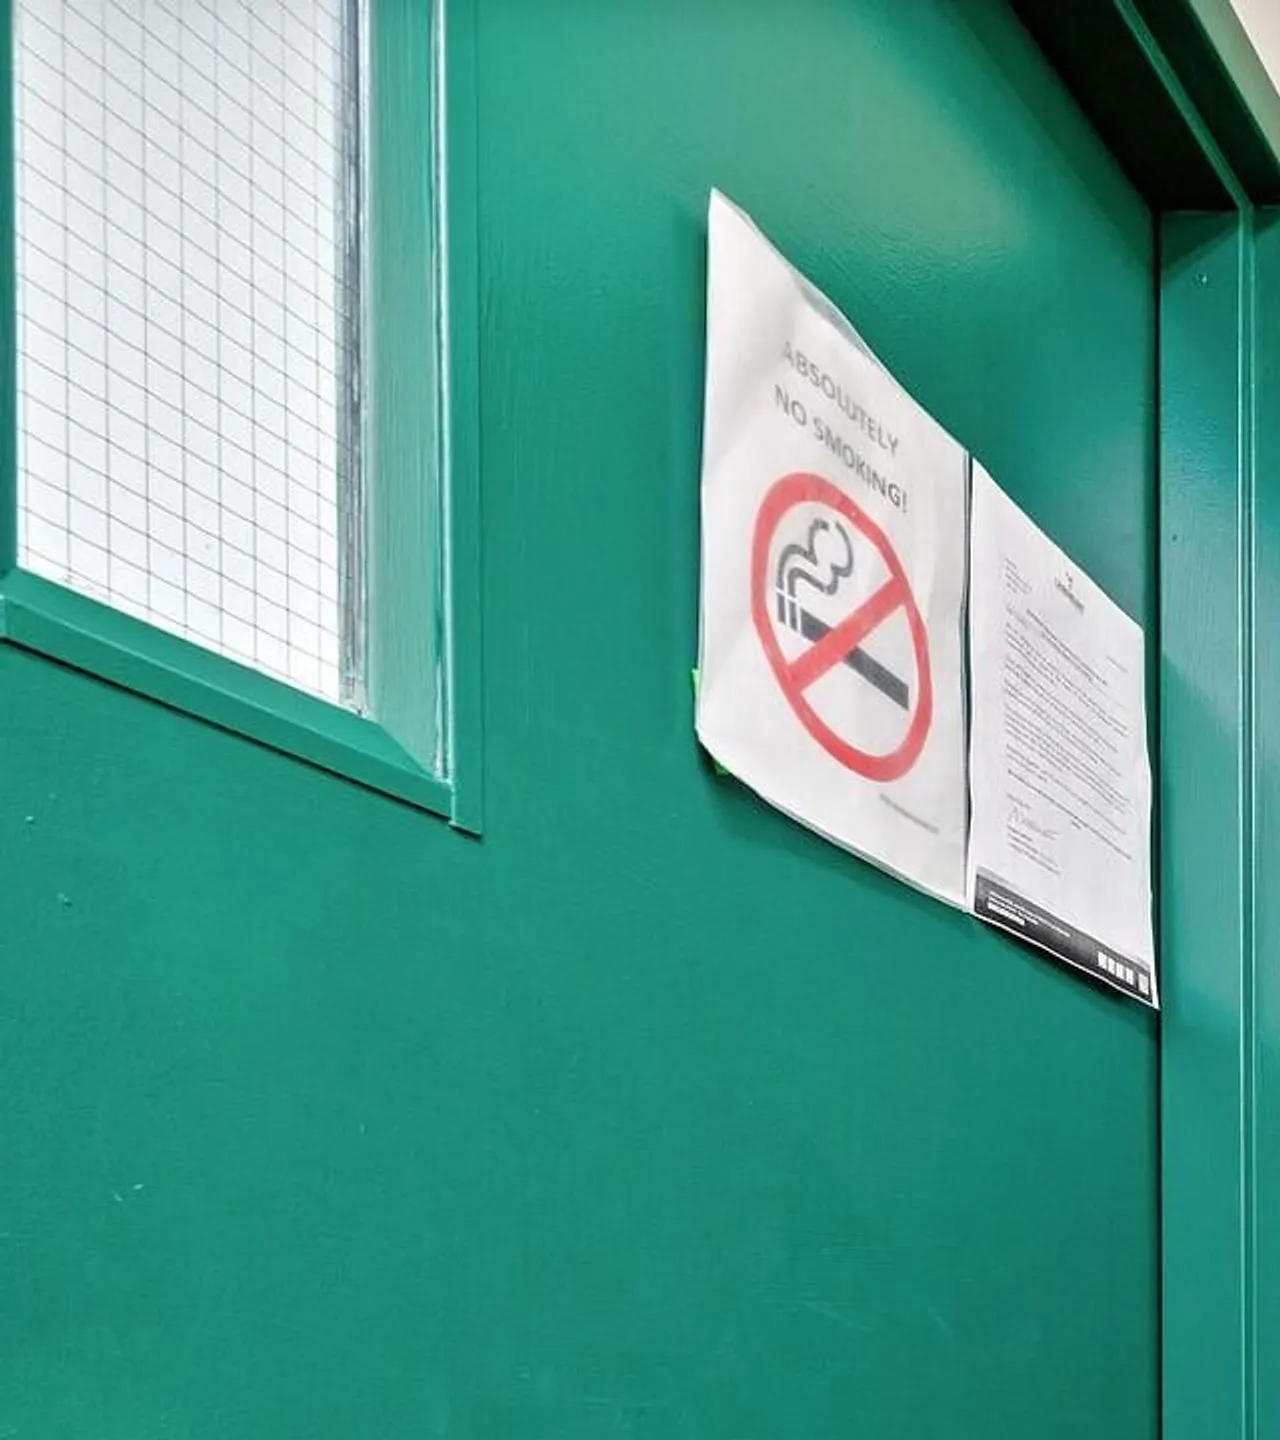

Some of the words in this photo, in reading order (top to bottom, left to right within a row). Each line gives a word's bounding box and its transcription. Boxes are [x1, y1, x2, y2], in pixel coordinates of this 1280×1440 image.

[774, 383, 807, 428] NO
[812, 413, 908, 514] SMOKING!
[781, 341, 900, 457] ABSOLUTELY
